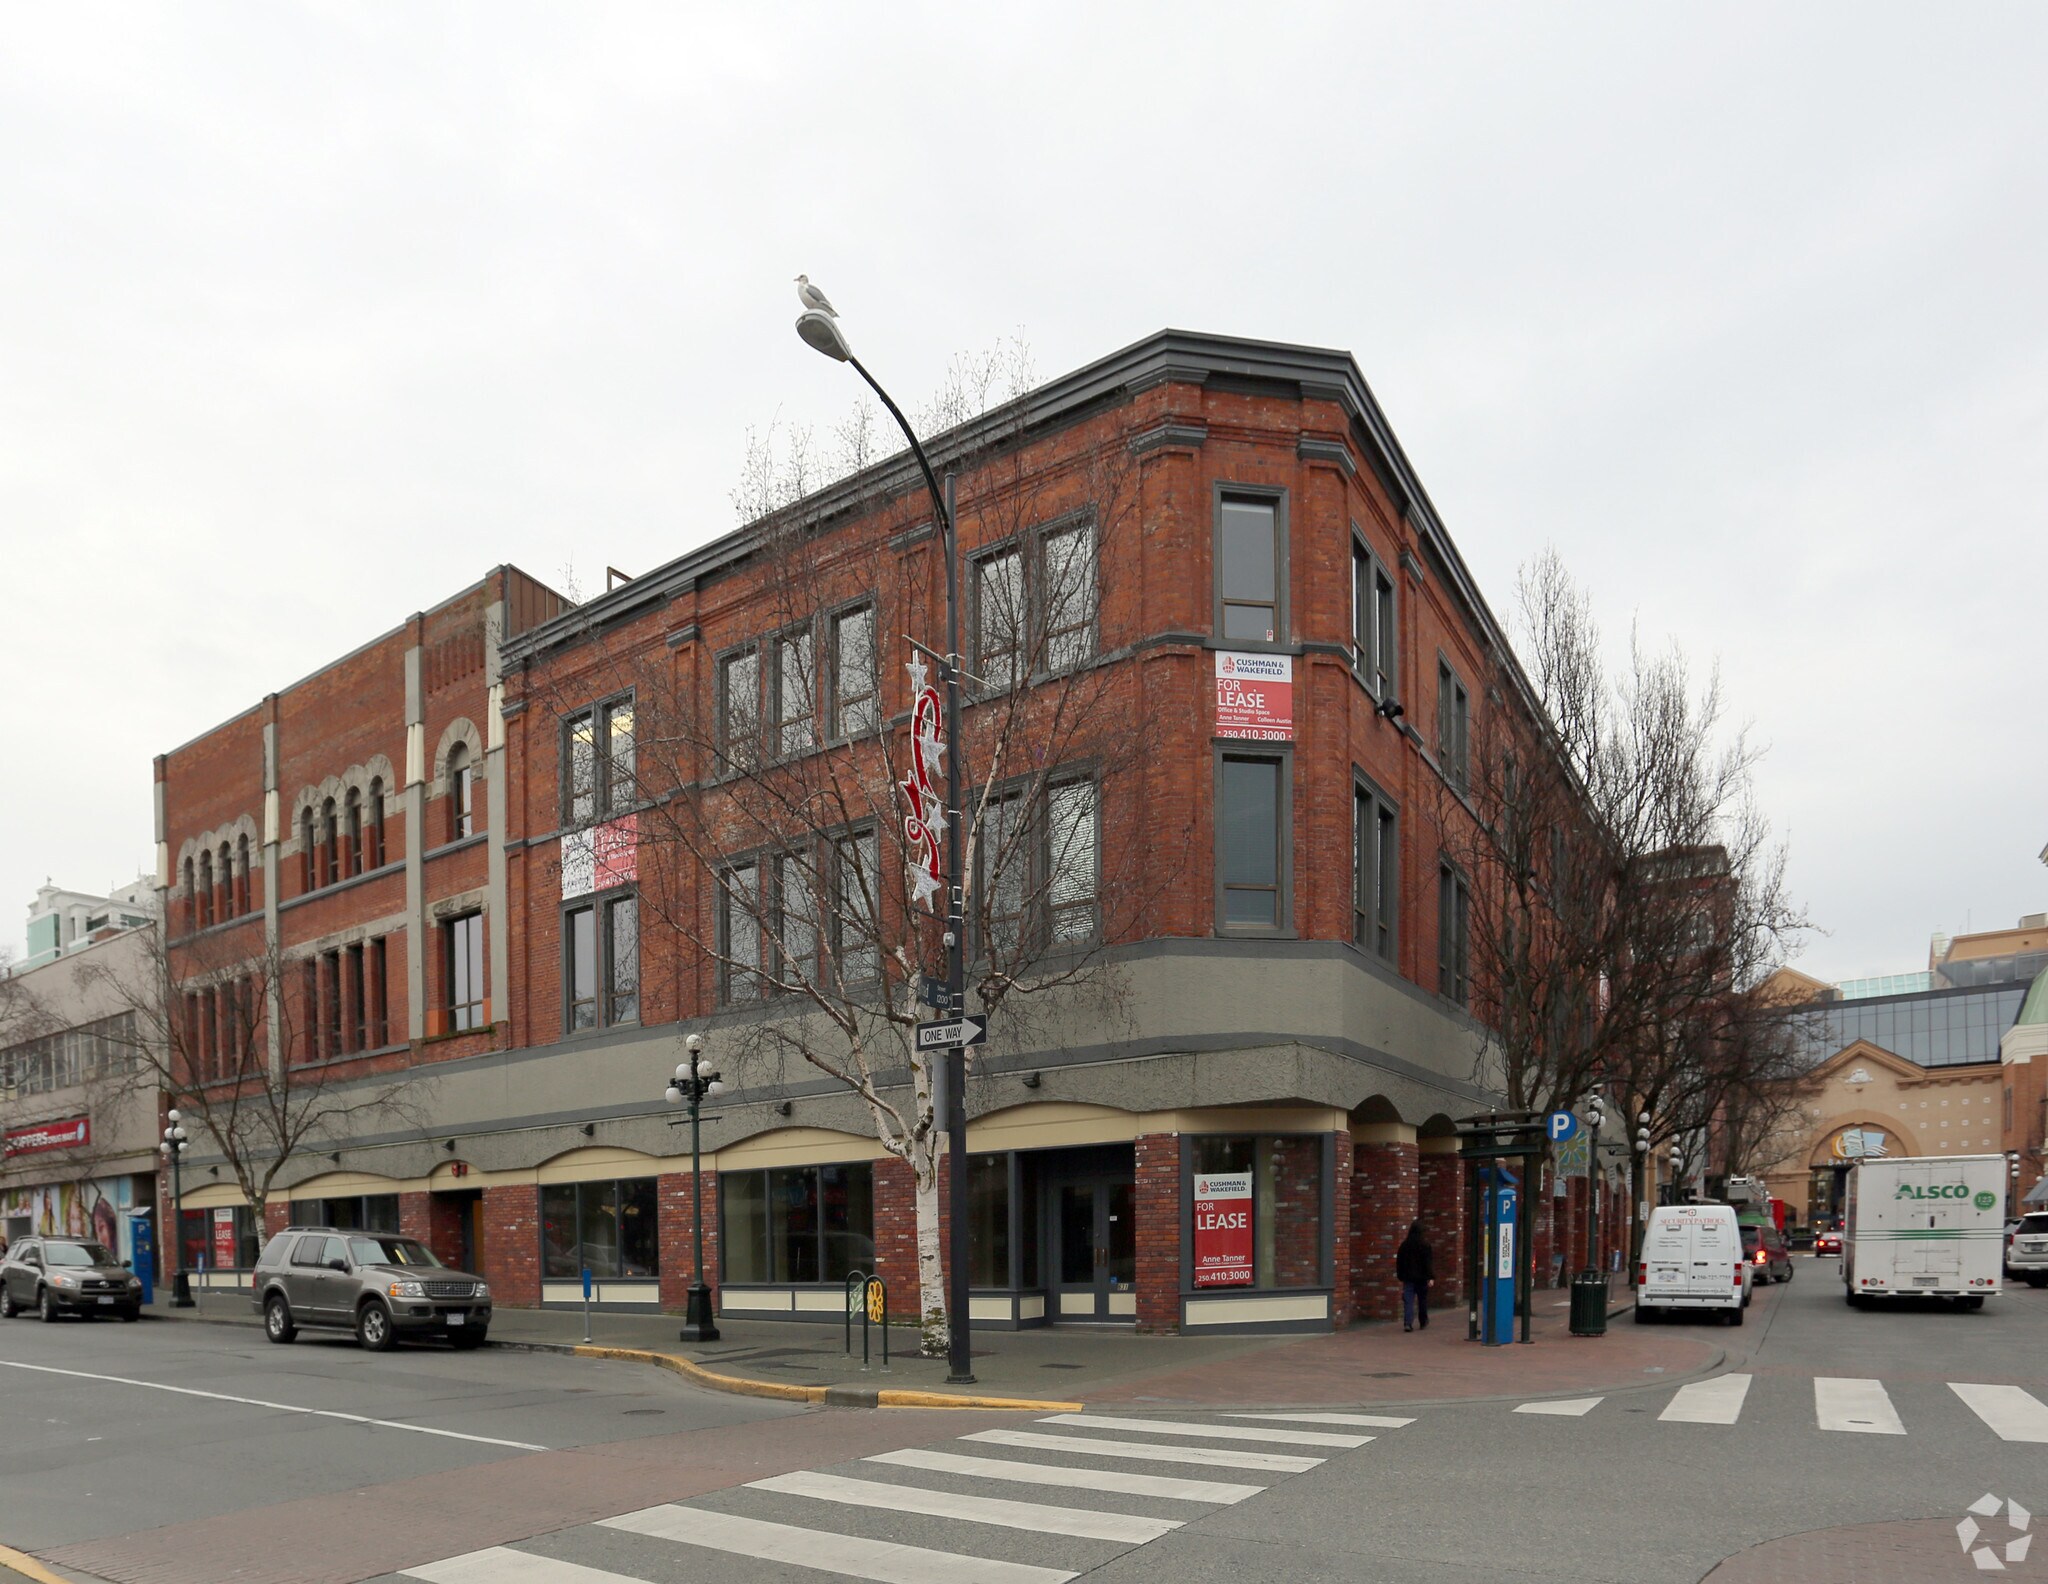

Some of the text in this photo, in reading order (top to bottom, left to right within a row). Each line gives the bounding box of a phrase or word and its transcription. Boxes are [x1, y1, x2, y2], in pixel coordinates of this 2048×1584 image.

[1236, 659, 1284, 669] CUSHMAN &
[1236, 666, 1283, 675] WAKEFIELD
[1218, 679, 1240, 691] FOR
[1218, 692, 1265, 708] LEASE
[1223, 729, 1286, 741] 250.410.3000
[937, 995, 948, 1004] 1200
[925, 1026, 963, 1042] ONE WAY
[1552, 1113, 1570, 1139] P
[1894, 1184, 1970, 1200] ALSCO
[1196, 1202, 1214, 1211] FOR
[1503, 1200, 1511, 1215] P
[1197, 1212, 1247, 1231] LEASE
[1660, 1216, 1726, 1226] SECURITY PATROLS
[216, 1229, 232, 1240] LEASE
[1202, 1254, 1246, 1263] Anne Tanner
[1198, 1270, 1250, 1282] 250.410.3000
